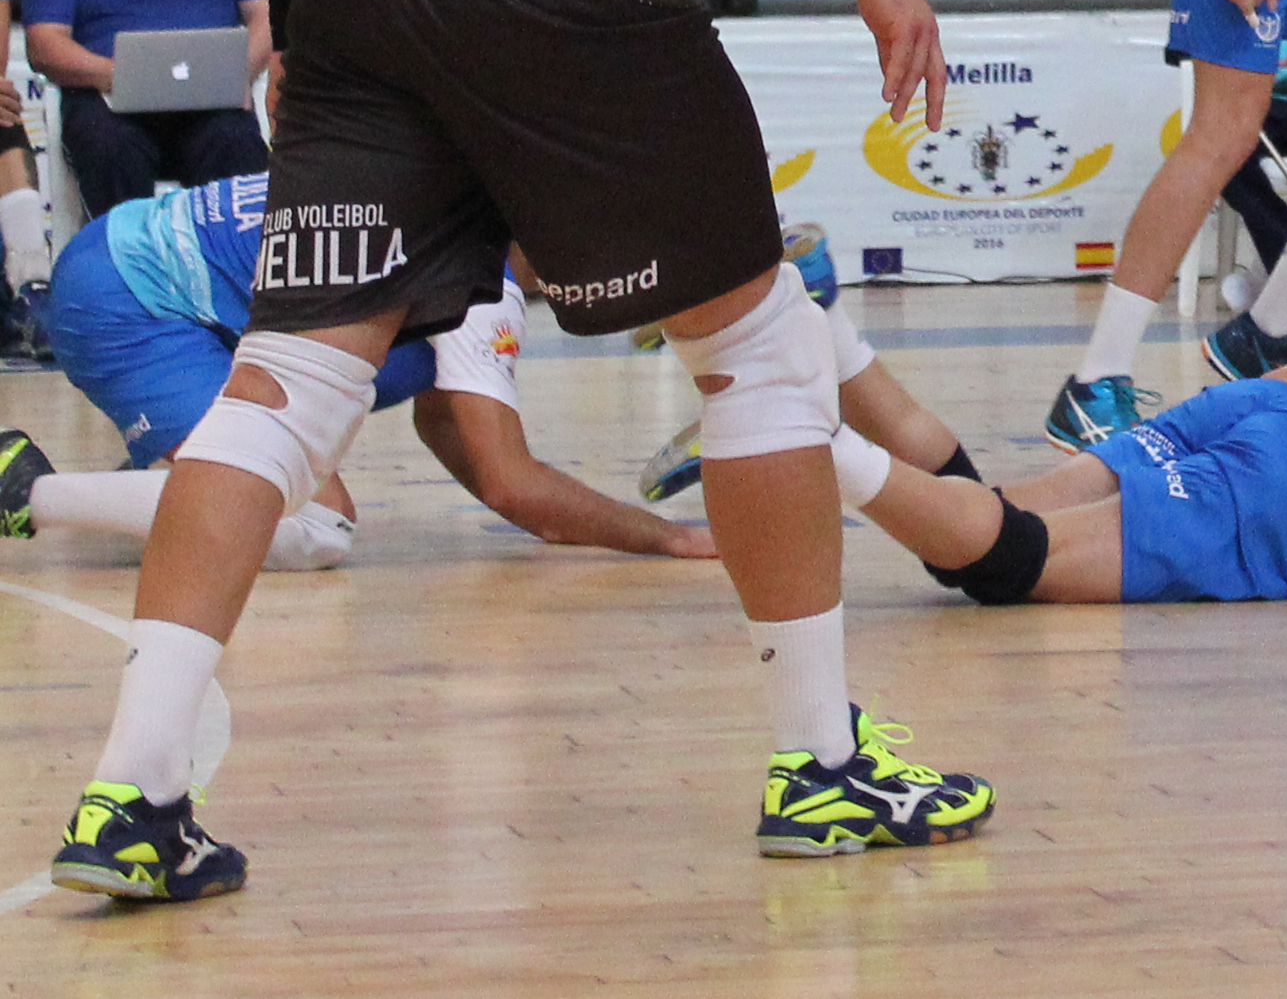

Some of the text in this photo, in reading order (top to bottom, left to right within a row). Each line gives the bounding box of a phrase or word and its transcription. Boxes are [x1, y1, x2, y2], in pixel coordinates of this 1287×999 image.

[945, 61, 1034, 85] Melilla
[263, 203, 388, 236] CLUB VOLEIBOL
[892, 206, 1085, 223] CIUDAD EUROPEA DEL DEPORTE
[973, 238, 1004, 249] 2016
